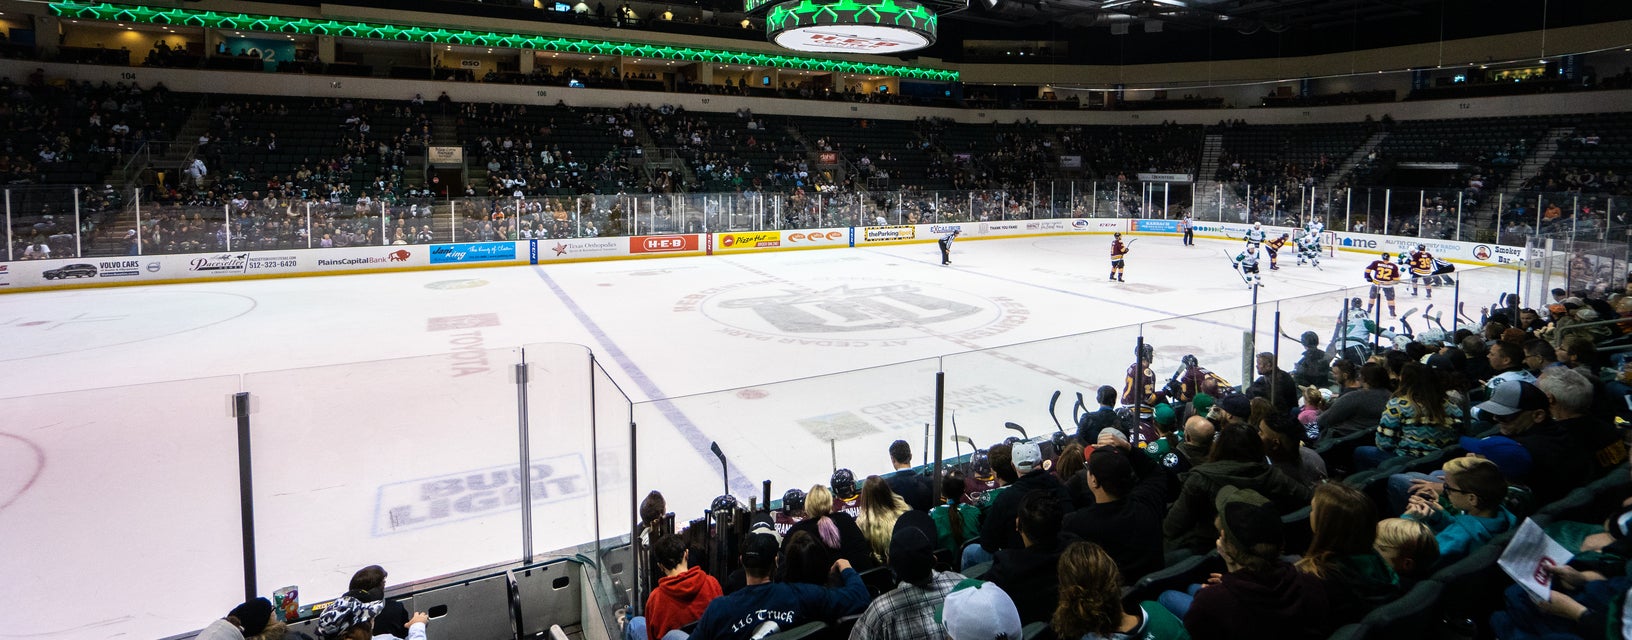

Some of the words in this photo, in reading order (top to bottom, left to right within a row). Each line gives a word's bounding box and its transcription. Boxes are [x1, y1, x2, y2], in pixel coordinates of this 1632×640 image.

[120, 72, 136, 80] 104
[584, 241, 617, 249] Orthopedics
[734, 236, 754, 245] Pizza
[432, 246, 453, 255] Jani
[468, 245, 478, 253] The
[1494, 246, 1521, 257] Smokey
[99, 261, 121, 270] VOLVO
[122, 260, 140, 268] CARS
[189, 257, 244, 272] Pacesetter
[249, 260, 297, 269] 512-323-6420
[317, 256, 388, 267] PlainsCapitalBank
[1498, 256, 1511, 264] Bar
[1376, 266, 1392, 280] 32
[449, 330, 491, 378] TOYOTA
[873, 392, 1019, 425] REGONAL
[419, 464, 554, 502] BUD
[389, 474, 580, 530] LIGHT
[731, 613, 753, 633] 116
[755, 608, 795, 623] Truck
